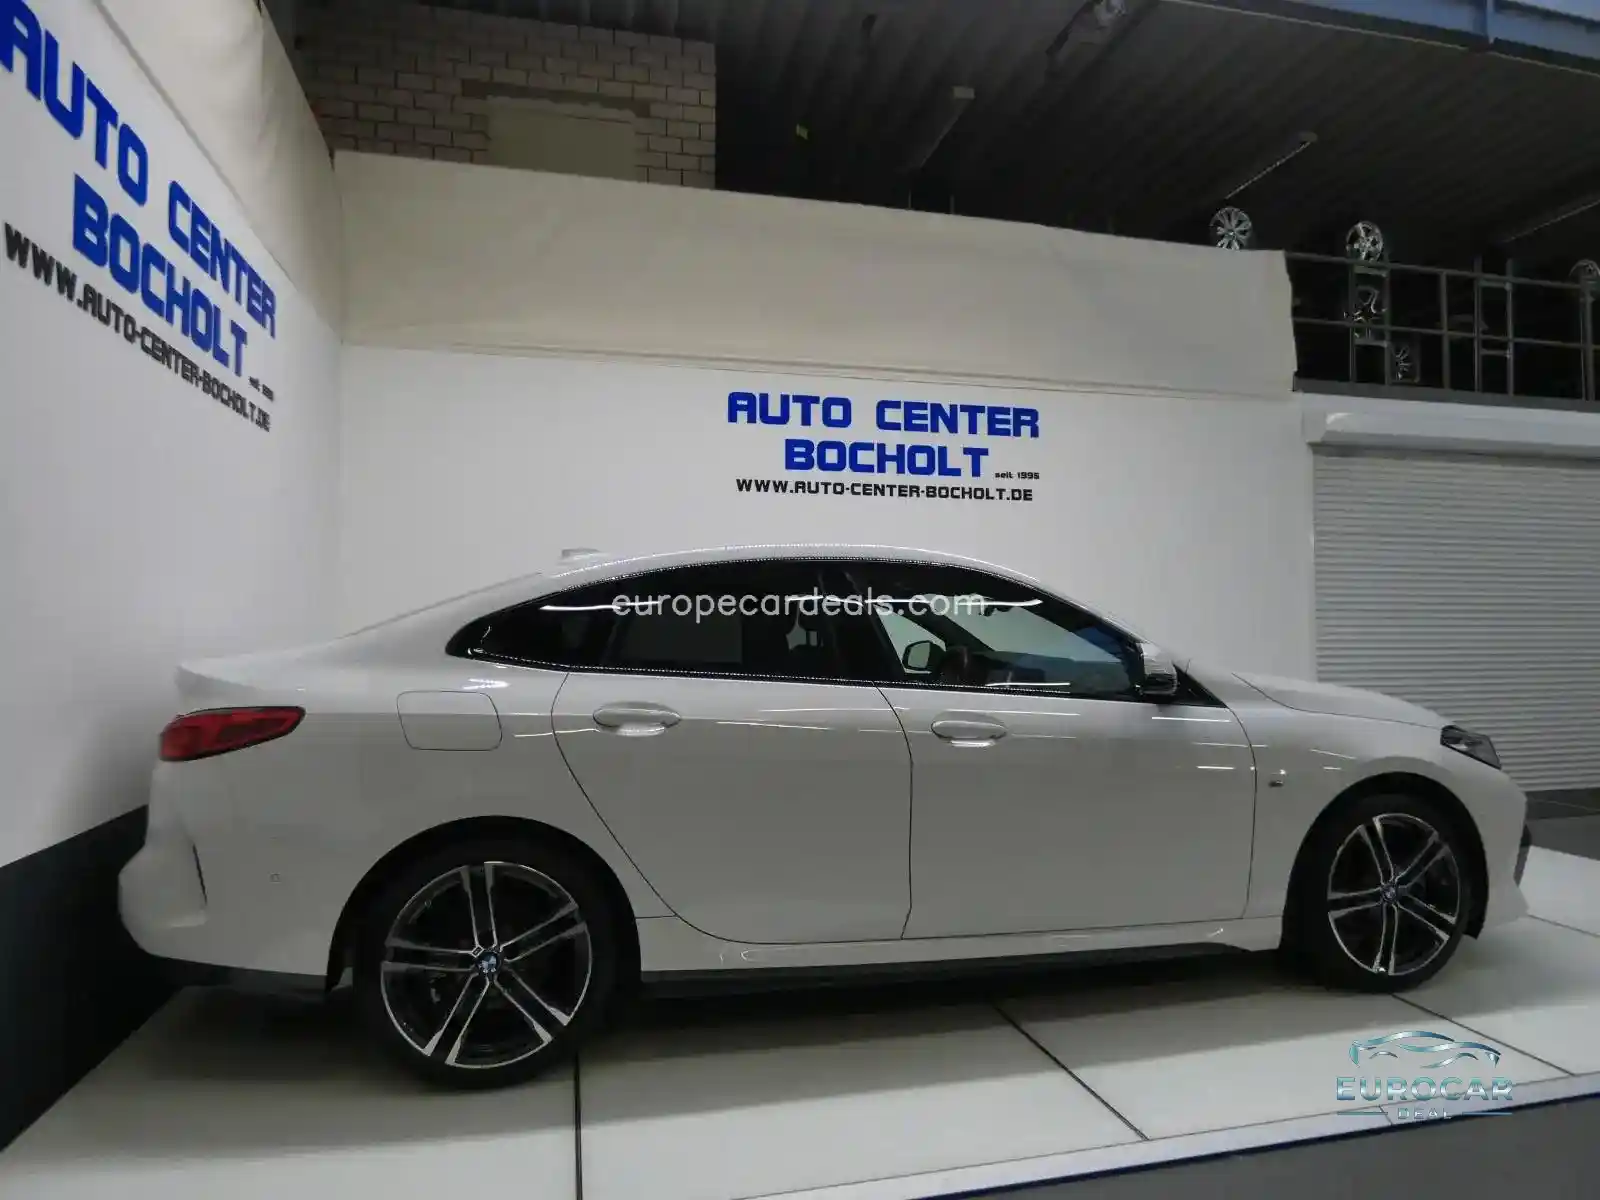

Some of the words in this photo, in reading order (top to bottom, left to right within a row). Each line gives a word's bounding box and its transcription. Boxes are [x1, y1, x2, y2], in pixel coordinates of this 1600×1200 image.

[0, 0, 148, 207] AUTO
[168, 180, 276, 339] CENTER
[73, 173, 248, 377] BOCHOLT
[5, 222, 271, 432] WWW.AUTO-CENTER-BOCHOLT.DE
[727, 391, 852, 428] AUTO
[876, 399, 1040, 438] CENTER
[785, 438, 989, 478] BOCHOLT
[995, 471, 1013, 479] seit
[736, 478, 1033, 501] WWW.AUTO-CENTER-BOCHOLT.DE
